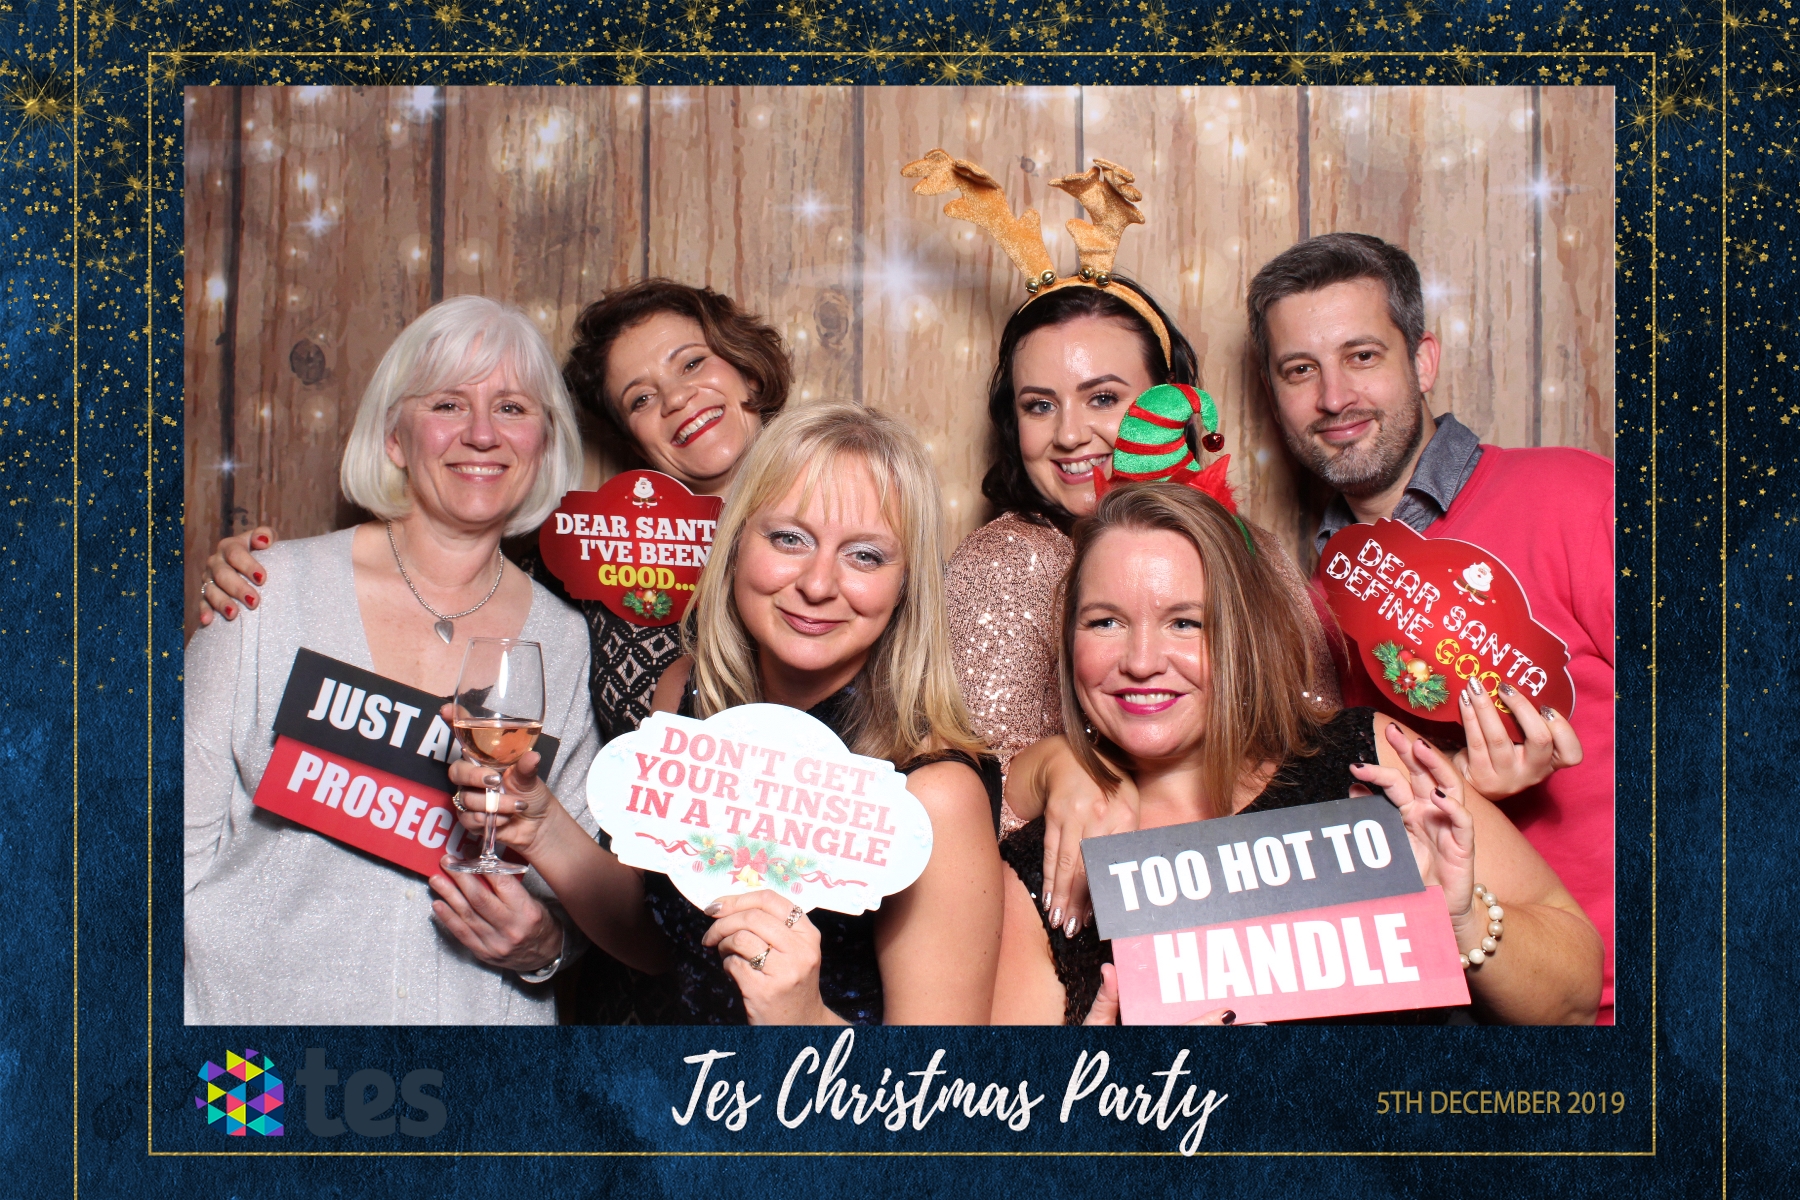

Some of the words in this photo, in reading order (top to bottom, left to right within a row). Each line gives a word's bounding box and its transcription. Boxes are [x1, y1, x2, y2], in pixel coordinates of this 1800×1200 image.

[555, 512, 629, 538] DEAR
[636, 516, 716, 542] SANT
[580, 538, 633, 563] I'VE
[639, 542, 712, 567] BEEN
[598, 563, 696, 592] GOOD...
[1326, 551, 1434, 645] DEFINE
[1357, 538, 1441, 613] DEAR
[1443, 605, 1548, 696] SANTA
[307, 677, 421, 748] JUST
[634, 752, 740, 801] YOUR
[753, 779, 896, 835] TINSEL
[659, 726, 785, 777] DON'T
[793, 756, 875, 796] GET
[286, 750, 500, 860] PROSECC
[625, 784, 674, 819] IN
[680, 798, 711, 828] A
[724, 805, 892, 867] TANGLE
[1108, 849, 1212, 911] TOO
[1217, 830, 1313, 893] HOT
[1321, 819, 1392, 874] TO
[1153, 912, 1420, 1004] HANDLE
